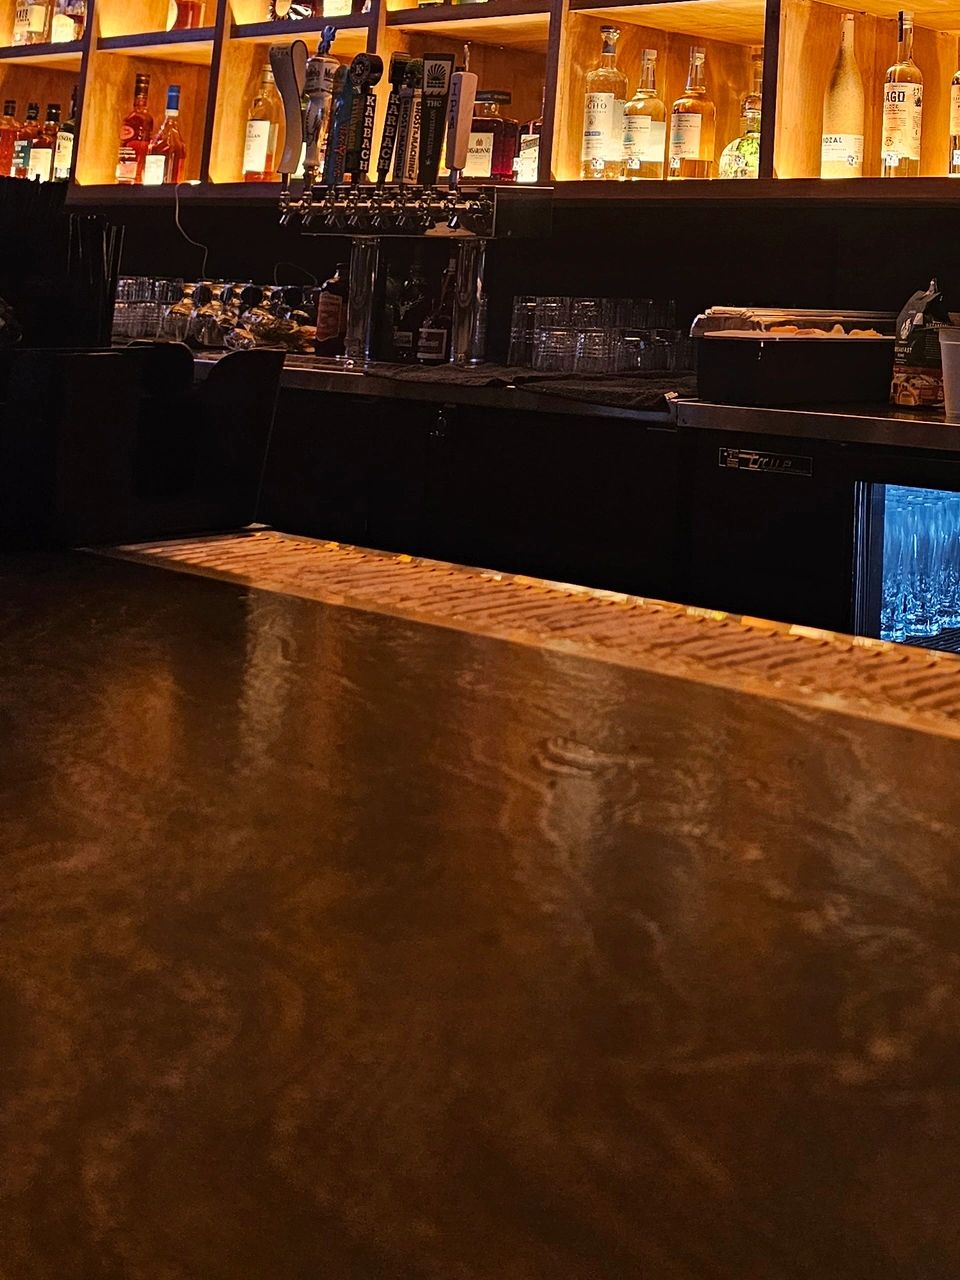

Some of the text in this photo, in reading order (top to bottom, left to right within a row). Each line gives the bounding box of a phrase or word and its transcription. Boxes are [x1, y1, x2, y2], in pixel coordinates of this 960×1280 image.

[360, 95, 375, 170] KARBACH
[380, 94, 400, 170] KARBACH
[412, 101, 422, 131] GHOST
